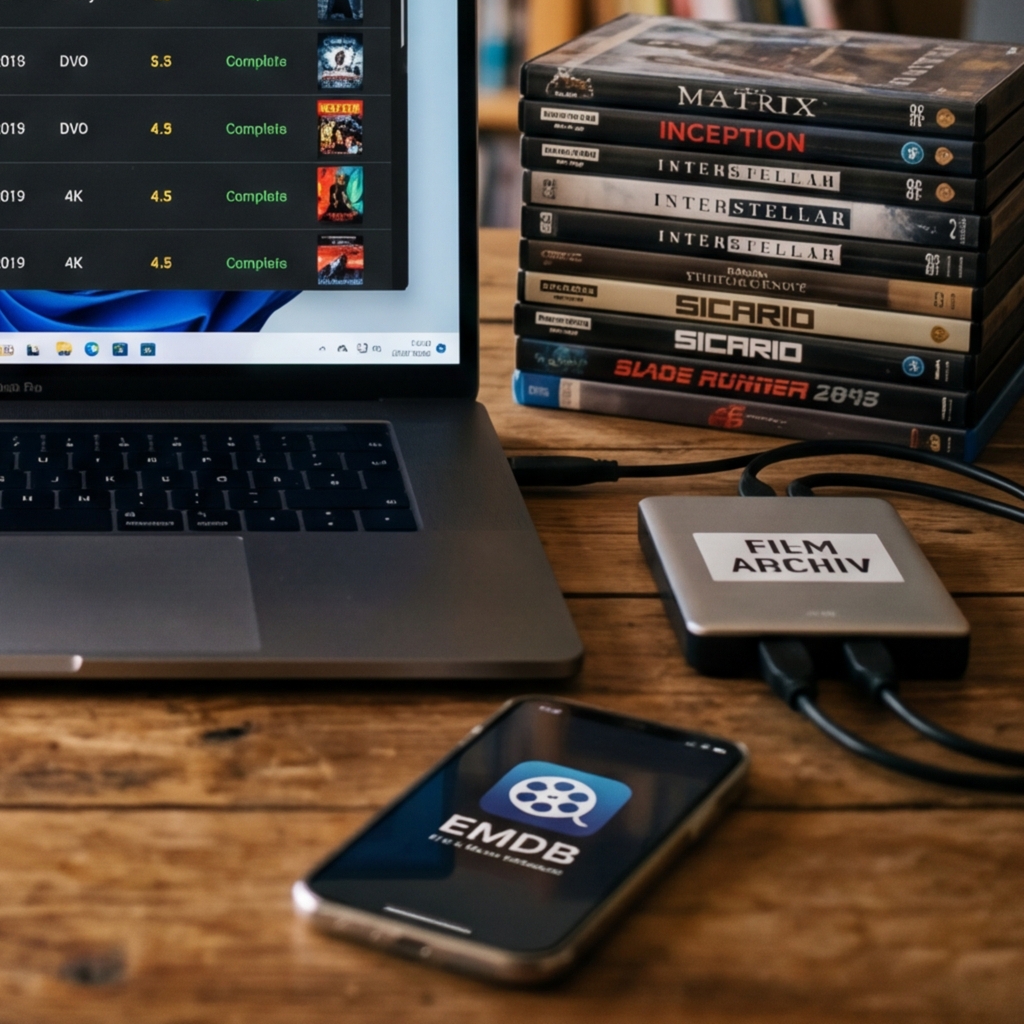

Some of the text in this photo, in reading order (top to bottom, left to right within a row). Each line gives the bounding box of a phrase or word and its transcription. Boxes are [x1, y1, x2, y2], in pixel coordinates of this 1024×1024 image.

[677, 85, 819, 118] MATRIX
[659, 120, 806, 153] INCEPTION
[64, 189, 83, 203] 4K
[150, 189, 173, 203] 4.5
[654, 192, 845, 227] INTERSTELLAR
[64, 256, 83, 269] 4K
[150, 256, 173, 270] 4.5
[675, 293, 815, 330] SICARIO
[674, 328, 804, 364] SICARIO
[732, 557, 871, 574] ARCHIV
[438, 813, 581, 865] EMDB
